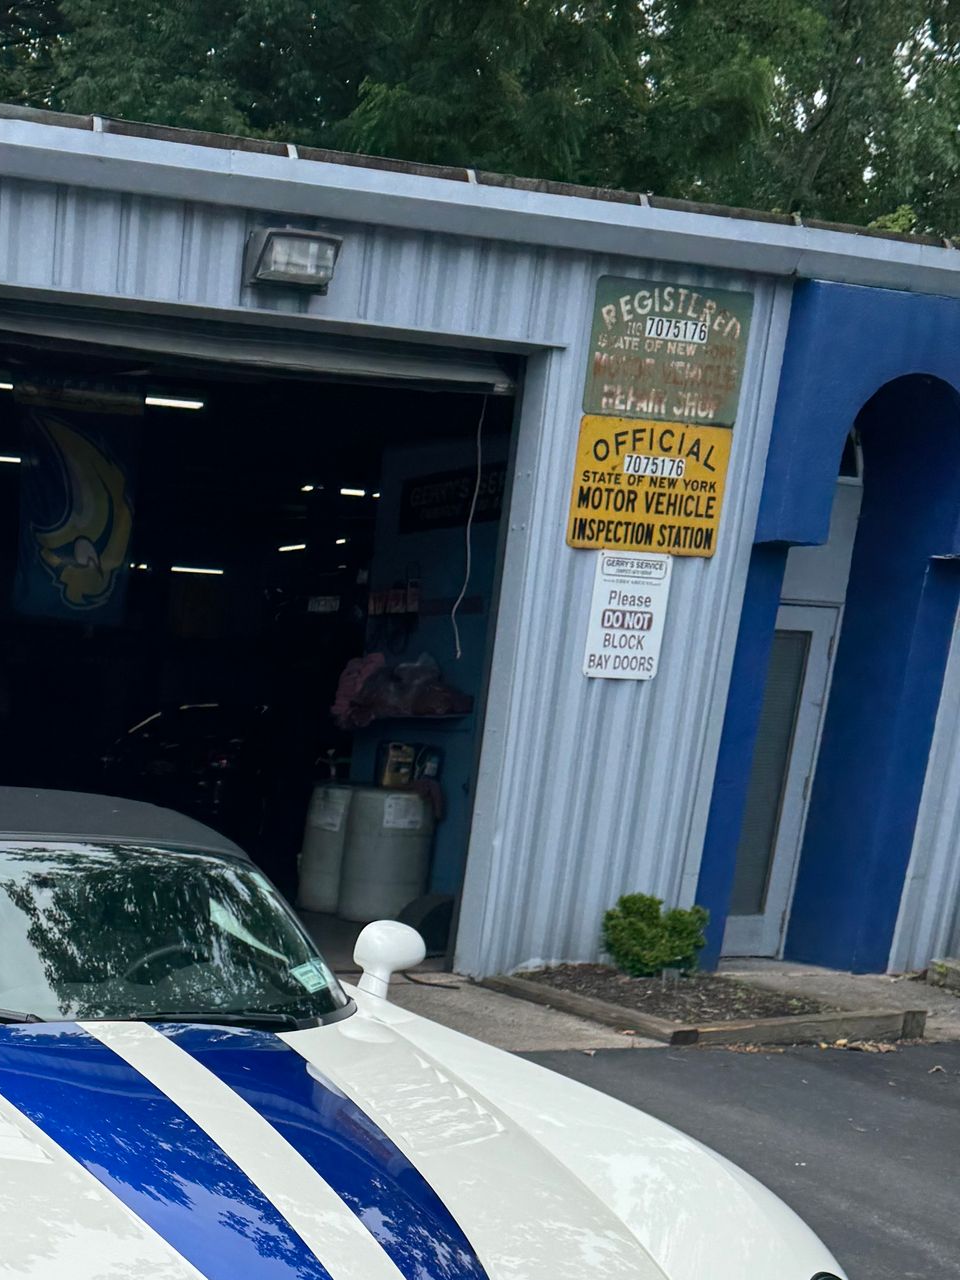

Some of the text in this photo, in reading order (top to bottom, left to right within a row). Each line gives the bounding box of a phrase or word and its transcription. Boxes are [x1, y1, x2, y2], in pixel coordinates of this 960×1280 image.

[647, 318, 707, 342] 7075176
[645, 339, 662, 353] OF
[666, 341, 698, 357] NEW
[593, 428, 715, 472] OFFICIAL
[625, 455, 684, 477] 7075176
[582, 470, 716, 493] STATE OF NEW YORK
[577, 486, 715, 519] MOTOR VEHICLE
[572, 518, 713, 550] INSPECTION STATION
[609, 590, 652, 608] Please
[604, 611, 651, 630] DO NOT
[603, 633, 644, 650] BLOCK
[588, 654, 654, 673] BAY DOORS
